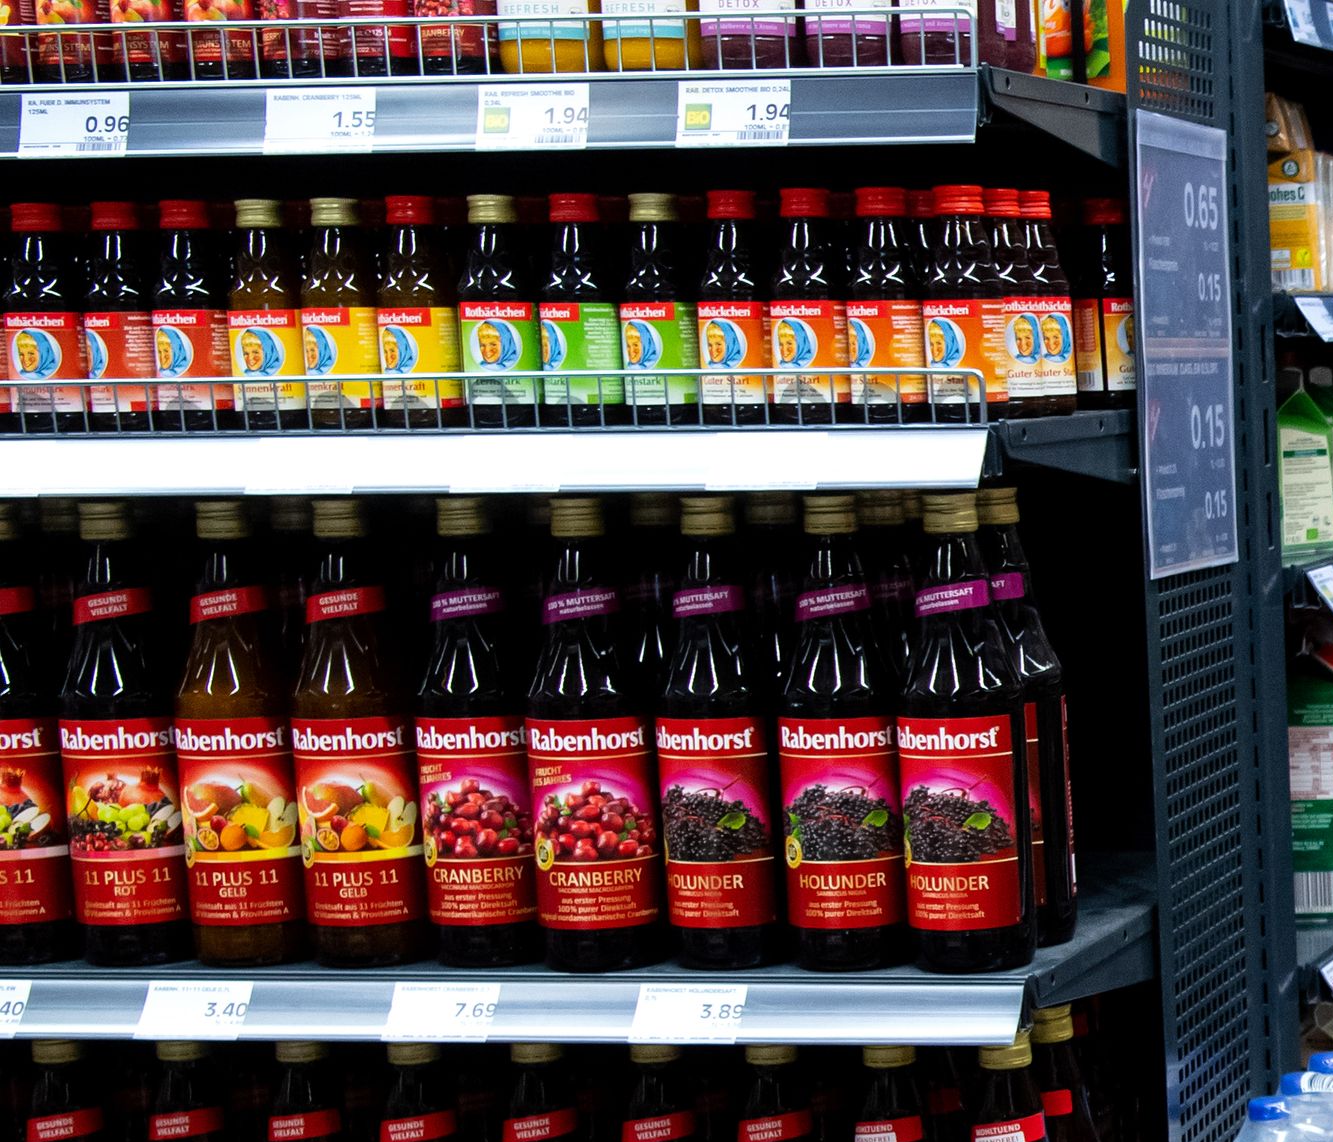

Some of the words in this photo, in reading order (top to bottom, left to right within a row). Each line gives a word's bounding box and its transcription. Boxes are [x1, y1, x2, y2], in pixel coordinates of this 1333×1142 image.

[332, 111, 375, 129] 1.55
[544, 107, 589, 124] 1.94
[746, 104, 790, 121] 1.94
[86, 116, 129, 133] 0.96
[1184, 182, 1219, 230] 0.65
[465, 305, 526, 318] Rotbäckchen
[1191, 403, 1225, 450] 0.15
[61, 725, 175, 751] Rabenhorst
[176, 725, 284, 751] Rabenhorst
[293, 725, 403, 751] Rabenhorst
[417, 725, 528, 751] Rabenhorst
[531, 725, 644, 751] Rabenhorst
[782, 725, 893, 751] Rabenhorst
[103, 869, 146, 886] PLUS
[152, 867, 171, 883] 11
[212, 871, 253, 887] PLUS
[259, 869, 279, 884] 11
[332, 870, 374, 887] PLUS
[380, 868, 398, 884] 11
[433, 865, 524, 884] CRANBERRY
[549, 867, 643, 887] CRANBERRY
[799, 872, 886, 891] HOLUNDER
[114, 885, 137, 897] ROT
[219, 887, 247, 898] GELB
[339, 887, 368, 899] GELB
[910, 875, 990, 893] HOLUNDER
[204, 1002, 248, 1018] 3.40
[455, 1002, 498, 1018] 7.69
[700, 1004, 745, 1020] 3.89
